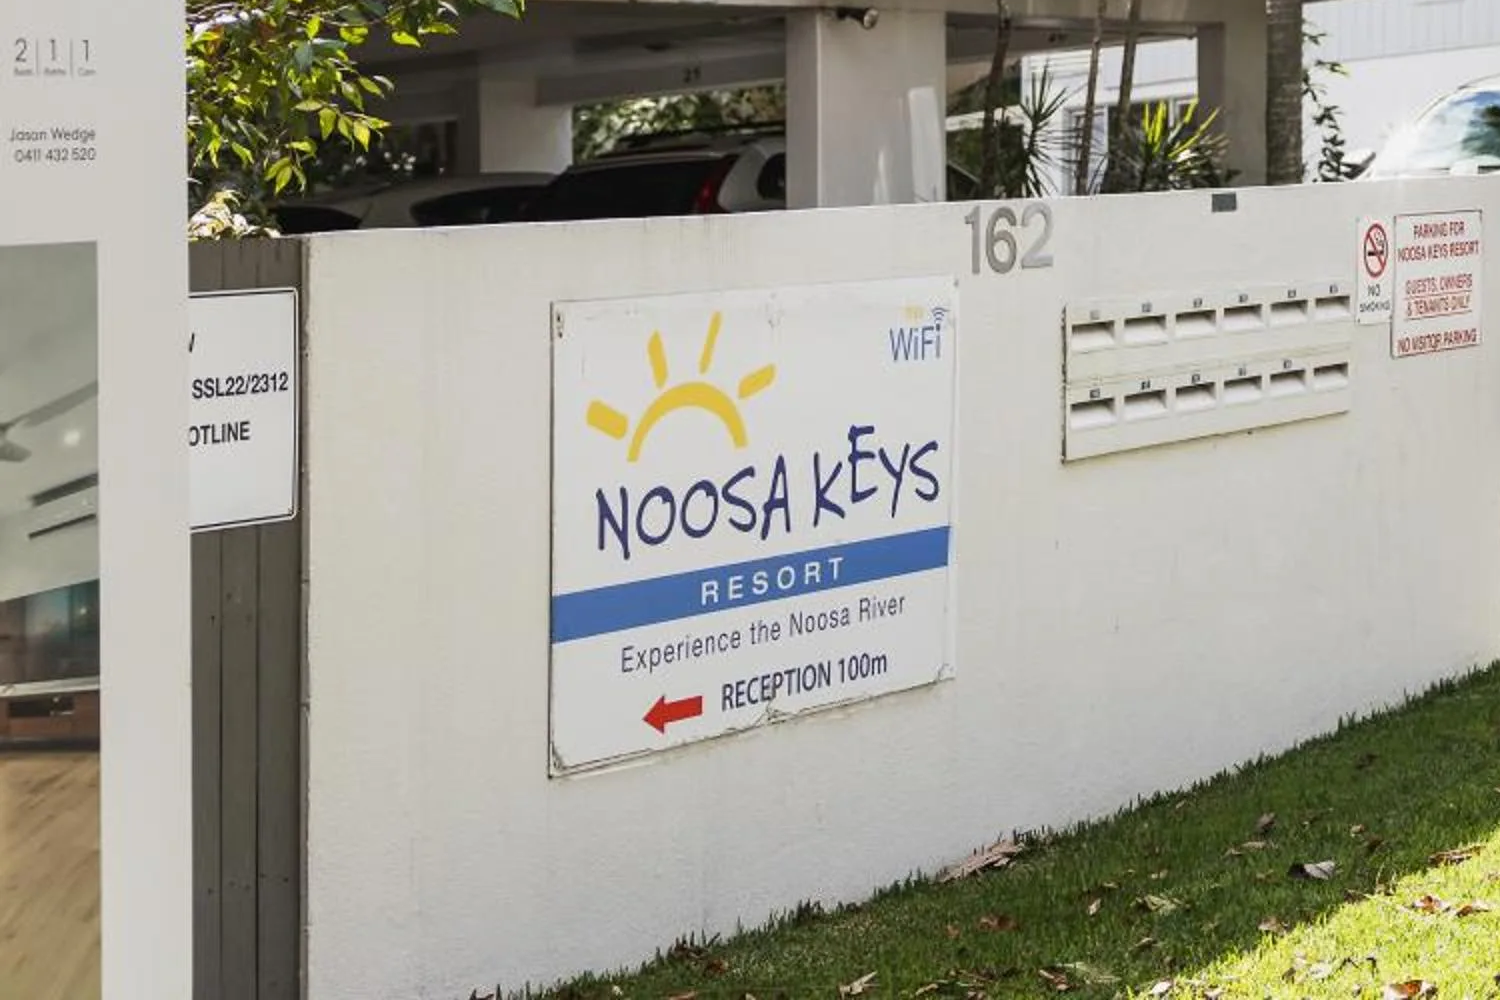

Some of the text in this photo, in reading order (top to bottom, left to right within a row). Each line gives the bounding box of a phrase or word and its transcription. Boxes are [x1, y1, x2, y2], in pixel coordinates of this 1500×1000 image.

[15, 38, 27, 62] 2
[9, 127, 96, 143] Jason Wedge
[14, 147, 97, 163] 0411 432 520
[964, 202, 1053, 274] 162
[1413, 222, 1447, 239] PARKING
[1397, 245, 1426, 262] NOOSA
[1449, 240, 1479, 257] RESORT
[1367, 284, 1380, 297] NO
[1359, 300, 1390, 313] SMOKING
[889, 323, 941, 361] WiFi
[1398, 328, 1477, 353] NO VISITOR PARKING
[191, 371, 288, 399] SSL22/2312
[595, 424, 941, 561] NOOSA KEYS
[700, 556, 846, 606] RESORT
[620, 594, 906, 674] Experience the Noosa River
[721, 652, 888, 712] RECEPTION 100m
